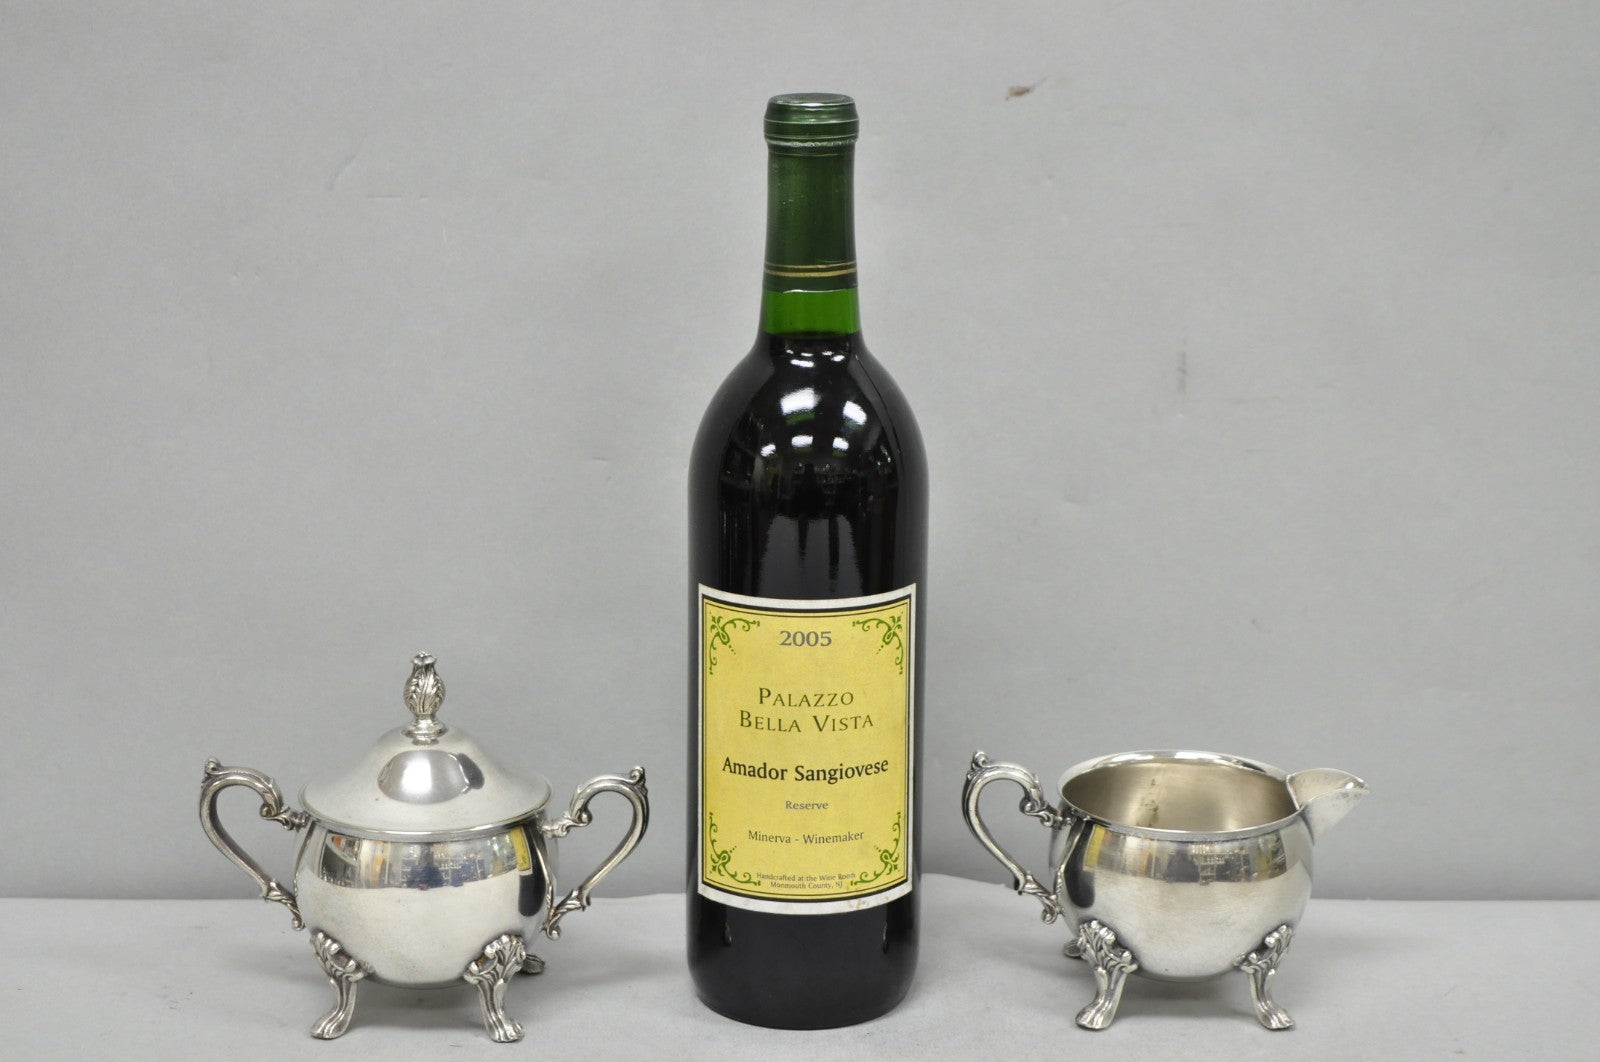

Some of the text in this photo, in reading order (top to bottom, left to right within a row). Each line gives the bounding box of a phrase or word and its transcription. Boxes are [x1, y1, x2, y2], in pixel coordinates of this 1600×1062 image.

[779, 630, 832, 647] 2005
[758, 687, 854, 707] PALAZZO
[739, 710, 874, 732] BELLA VISTA
[722, 756, 889, 784] Amador Sangiovese
[785, 800, 829, 810] Reserve
[748, 830, 791, 844] Minerva
[802, 831, 864, 844] Winemaker
[756, 872, 796, 881] Handcrafted
[770, 881, 806, 889] Monmouth
